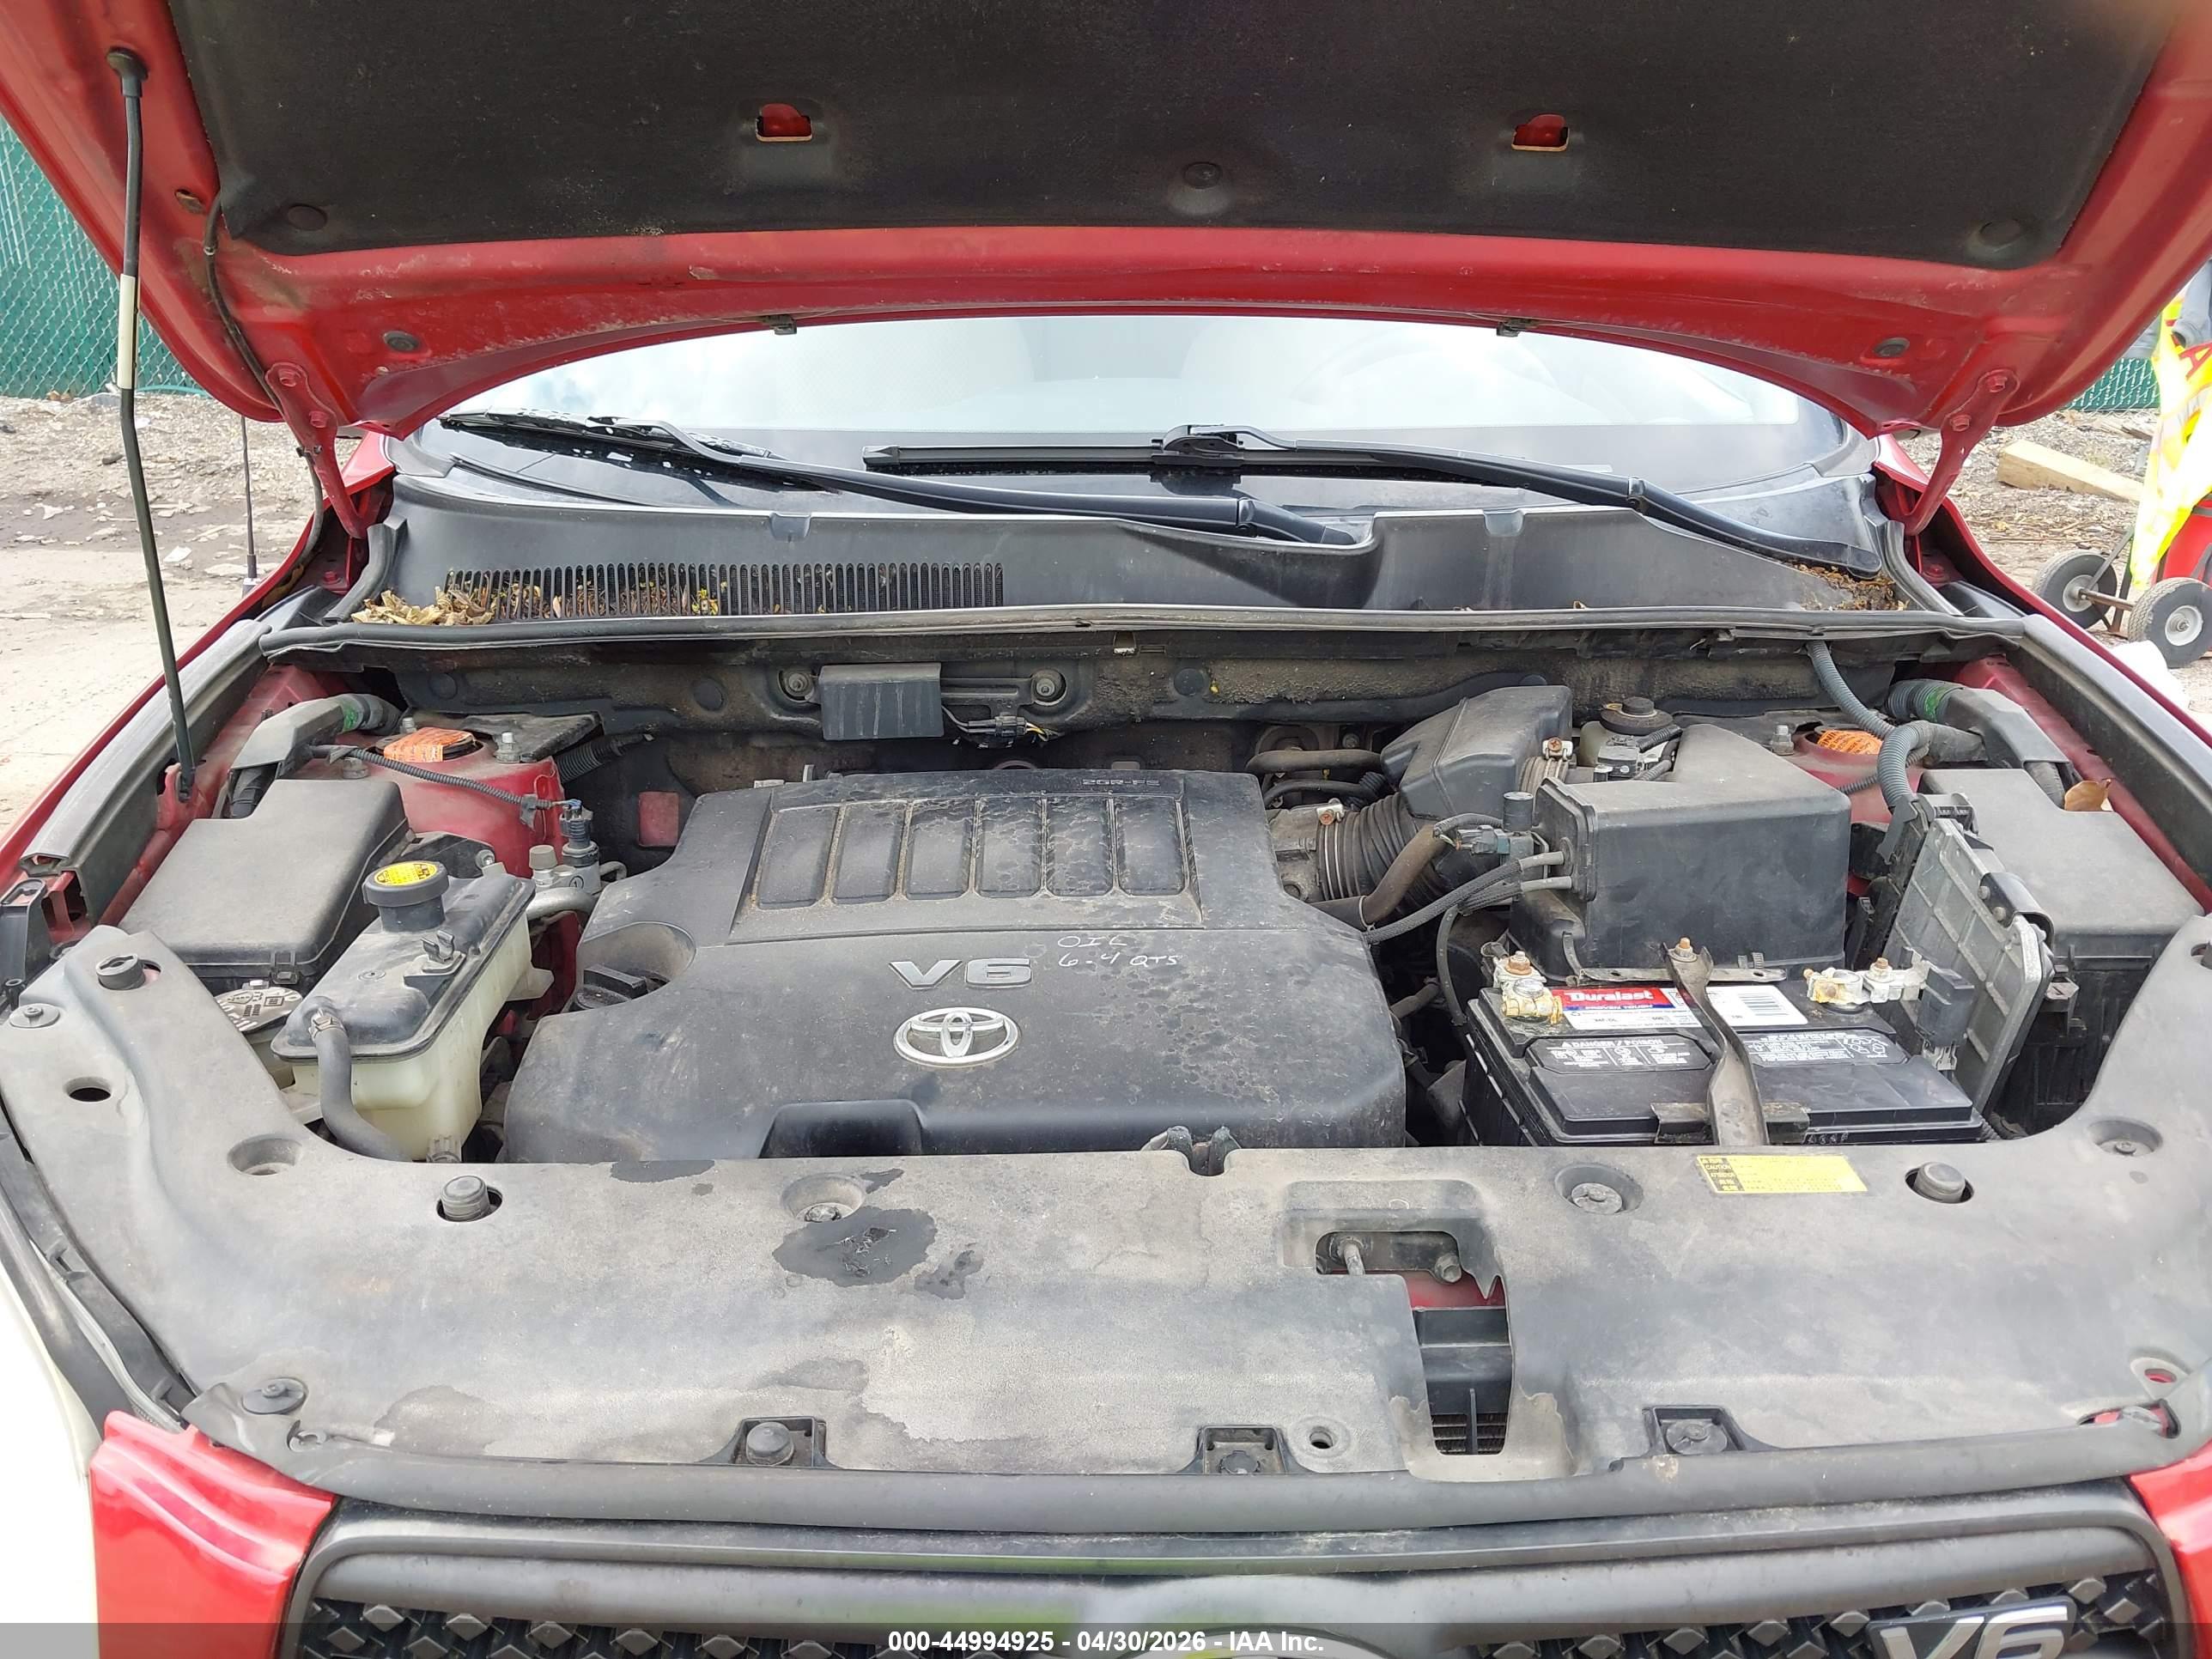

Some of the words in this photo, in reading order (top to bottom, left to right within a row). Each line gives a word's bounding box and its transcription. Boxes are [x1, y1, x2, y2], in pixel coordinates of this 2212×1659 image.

[1058, 936, 1127, 947] OIL
[1129, 955, 1181, 968] QTS
[890, 958, 1031, 988] V6
[1565, 990, 1654, 1002] Duralast
[1572, 1040, 1616, 1048] DANGER
[1625, 1038, 1664, 1047] POISON
[1880, 1605, 2069, 1659] V6
